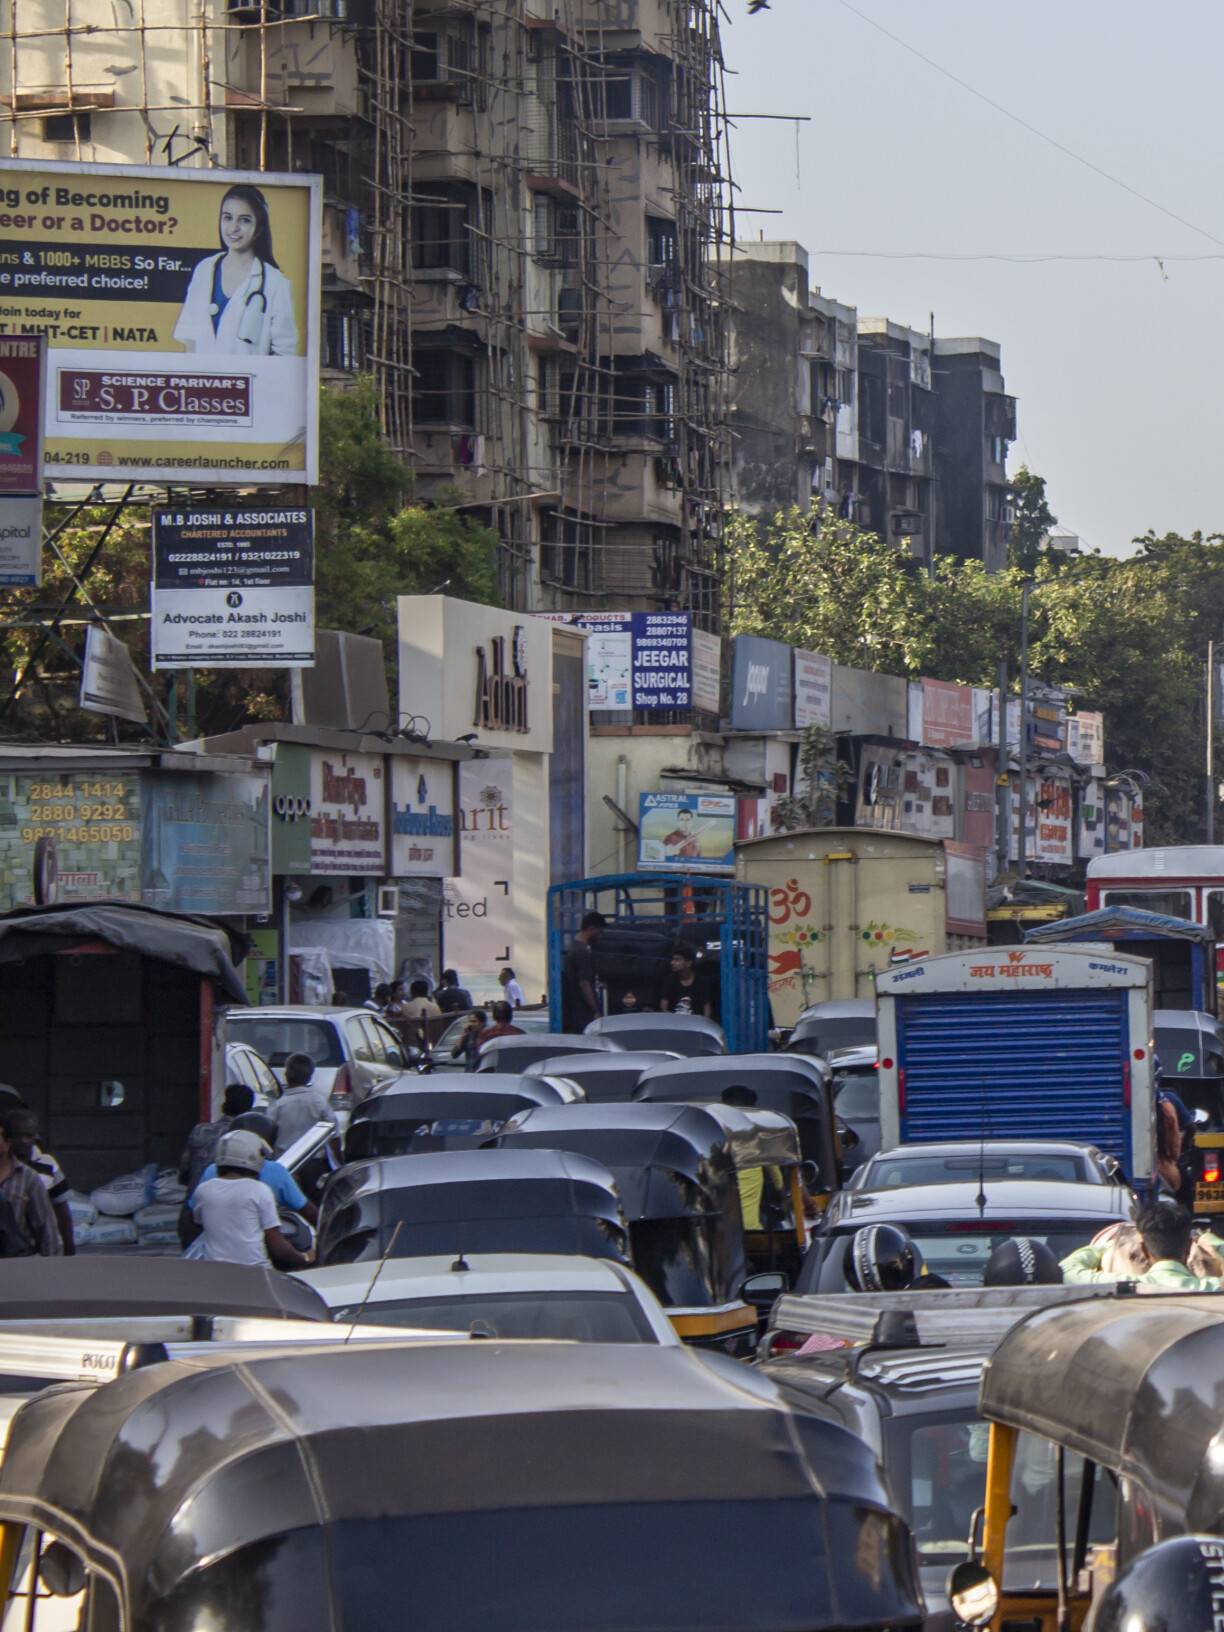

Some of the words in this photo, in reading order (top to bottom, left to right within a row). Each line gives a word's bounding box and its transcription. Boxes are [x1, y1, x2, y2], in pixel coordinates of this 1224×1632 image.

[26, 187, 50, 207] of
[55, 188, 170, 215] Becoming
[42, 216, 65, 230] or
[70, 216, 84, 231] a
[90, 213, 178, 235] Doctor?
[22, 251, 35, 266] &
[39, 252, 81, 268] 1000+
[85, 254, 131, 269] MBBS
[134, 255, 155, 270] So
[158, 256, 192, 272] Far...
[14, 272, 88, 288] preferred
[91, 273, 149, 289] choice!
[24, 307, 61, 322] today
[63, 308, 81, 320] for
[21, 324, 100, 342] MHT-CET
[113, 328, 158, 342] NATA
[73, 379, 90, 399] SP
[101, 375, 166, 387] SCIENCE
[170, 376, 246, 389] PARIVAR'S
[131, 388, 150, 410] P.
[158, 388, 246, 414] Classes
[70, 413, 104, 422] Referred
[105, 414, 115, 423] by
[150, 416, 185, 424] preferred
[186, 416, 196, 424] by
[44, 453, 90, 466] 04-219
[117, 454, 290, 469] www.careerlauncher.com
[161, 514, 184, 526] M.B
[186, 514, 221, 525] JOSHI
[224, 513, 233, 524] &
[236, 512, 307, 525] ASSOCIATES
[0, 526, 30, 541] pital
[181, 530, 228, 539] CHARTERED
[229, 528, 288, 538] ACCOUNTANTS
[241, 551, 300, 561] 9321022319
[163, 613, 223, 624] Advocate
[226, 612, 267, 624] Akash
[271, 611, 307, 623] Joshi
[222, 630, 238, 639] 022
[634, 651, 689, 667] JEEGAR
[634, 672, 690, 689] SURGICAL
[635, 692, 658, 707] Shop
[660, 693, 675, 704] No.
[676, 692, 688, 704] 28
[30, 784, 74, 799] 2844
[81, 783, 125, 798] 1414
[655, 794, 689, 802] ASTRAL
[30, 805, 75, 821] 2880
[80, 804, 125, 820] 9292
[275, 796, 312, 822] oppo
[969, 965, 995, 979] जय
